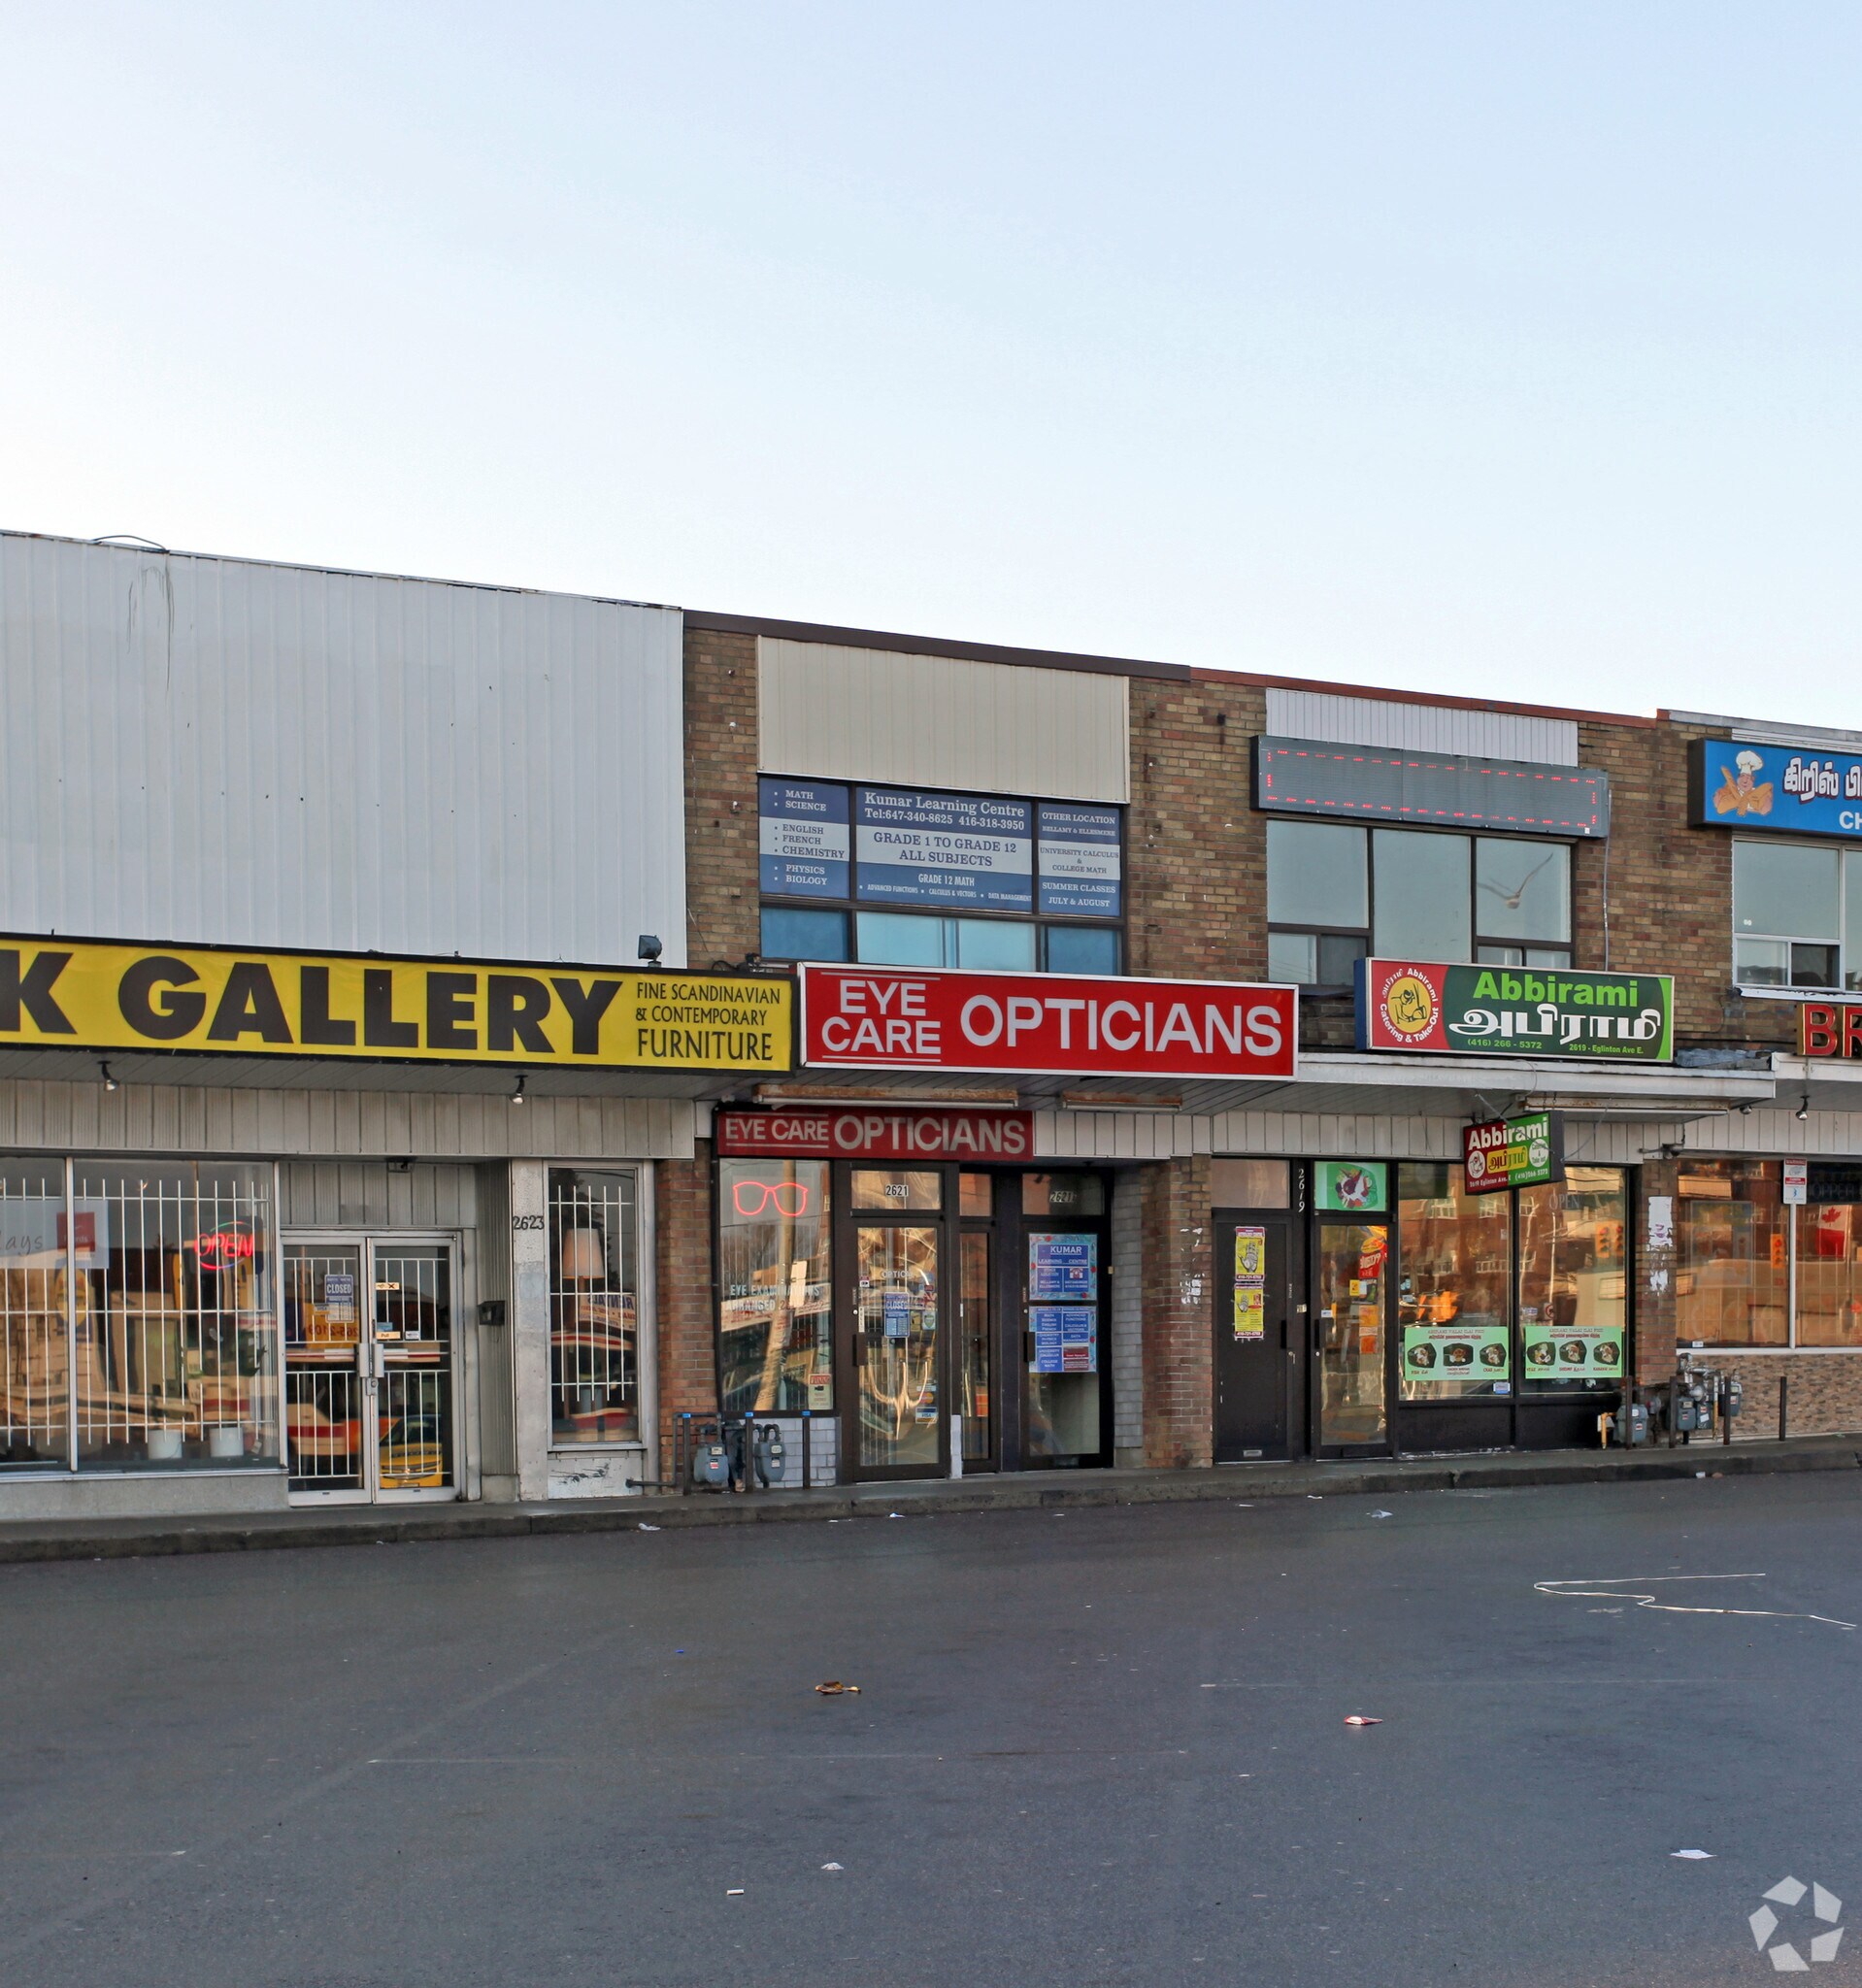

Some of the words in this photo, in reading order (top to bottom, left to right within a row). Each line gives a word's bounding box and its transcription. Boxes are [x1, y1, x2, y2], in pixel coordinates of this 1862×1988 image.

[785, 790, 814, 800] MATH
[865, 792, 913, 807] Kumar
[916, 796, 977, 815] Learning
[981, 802, 1025, 816] Centre
[785, 801, 827, 812] SCIENCE
[865, 808, 952, 824] Tel:647-340-8625
[958, 816, 1024, 830] 416-318-3950
[1043, 812, 1071, 821] OTHER
[1073, 814, 1115, 824] LOCATION
[782, 824, 823, 834] ENGLISH
[782, 835, 821, 845] FRENCH
[874, 832, 921, 845] GRADE
[925, 837, 930, 846] 1
[934, 837, 950, 847] TO
[955, 839, 1000, 852] GRADE
[1005, 843, 1016, 853] 12
[782, 845, 845, 858] CHEMISTRY
[900, 850, 925, 861] ALL
[929, 852, 992, 866] SUBJECTS
[1040, 847, 1081, 856] UNIVERSITY
[785, 864, 825, 874] PHYSICS
[785, 875, 827, 885] BIOLOGY
[918, 874, 942, 884] GRADE
[944, 876, 952, 885] 12
[954, 877, 975, 886] MATH
[1043, 882, 1079, 891] SUMMER
[1048, 896, 1069, 905] JULY
[1078, 899, 1110, 908] AUGUST
[637, 982, 666, 1000] FINE
[672, 984, 780, 1004] SCANDINAVIAN
[1408, 968, 1439, 1002] Abbirami
[1473, 972, 1638, 1007] Abbirami
[0, 949, 78, 1034] K
[117, 955, 623, 1054] GALLERY
[840, 979, 926, 1017] EYE
[636, 1008, 647, 1021] &
[652, 1006, 767, 1025] CONTEMPORARY
[960, 994, 1281, 1056] OPTICIANS
[1380, 1004, 1403, 1043] Catering
[1413, 1007, 1439, 1043] Take-Out
[1448, 1003, 1661, 1044] அபிராமி
[821, 1017, 942, 1054] CARE
[1803, 1003, 1862, 1057] BR
[638, 1029, 773, 1061] FURNITURE
[1592, 1044, 1621, 1054] Eglinton
[726, 1118, 769, 1140] EYE
[771, 1118, 829, 1142] CARE
[834, 1115, 1025, 1155] OPTICIANS
[1468, 1116, 1547, 1150] Abbirami
[885, 1185, 908, 1196] 2621
[513, 1214, 545, 1230] 2623
[0, 1230, 43, 1257] ays
[194, 1233, 254, 1257] OPEN
[327, 1284, 351, 1293] CLOSED
[730, 1284, 747, 1296] EYE
